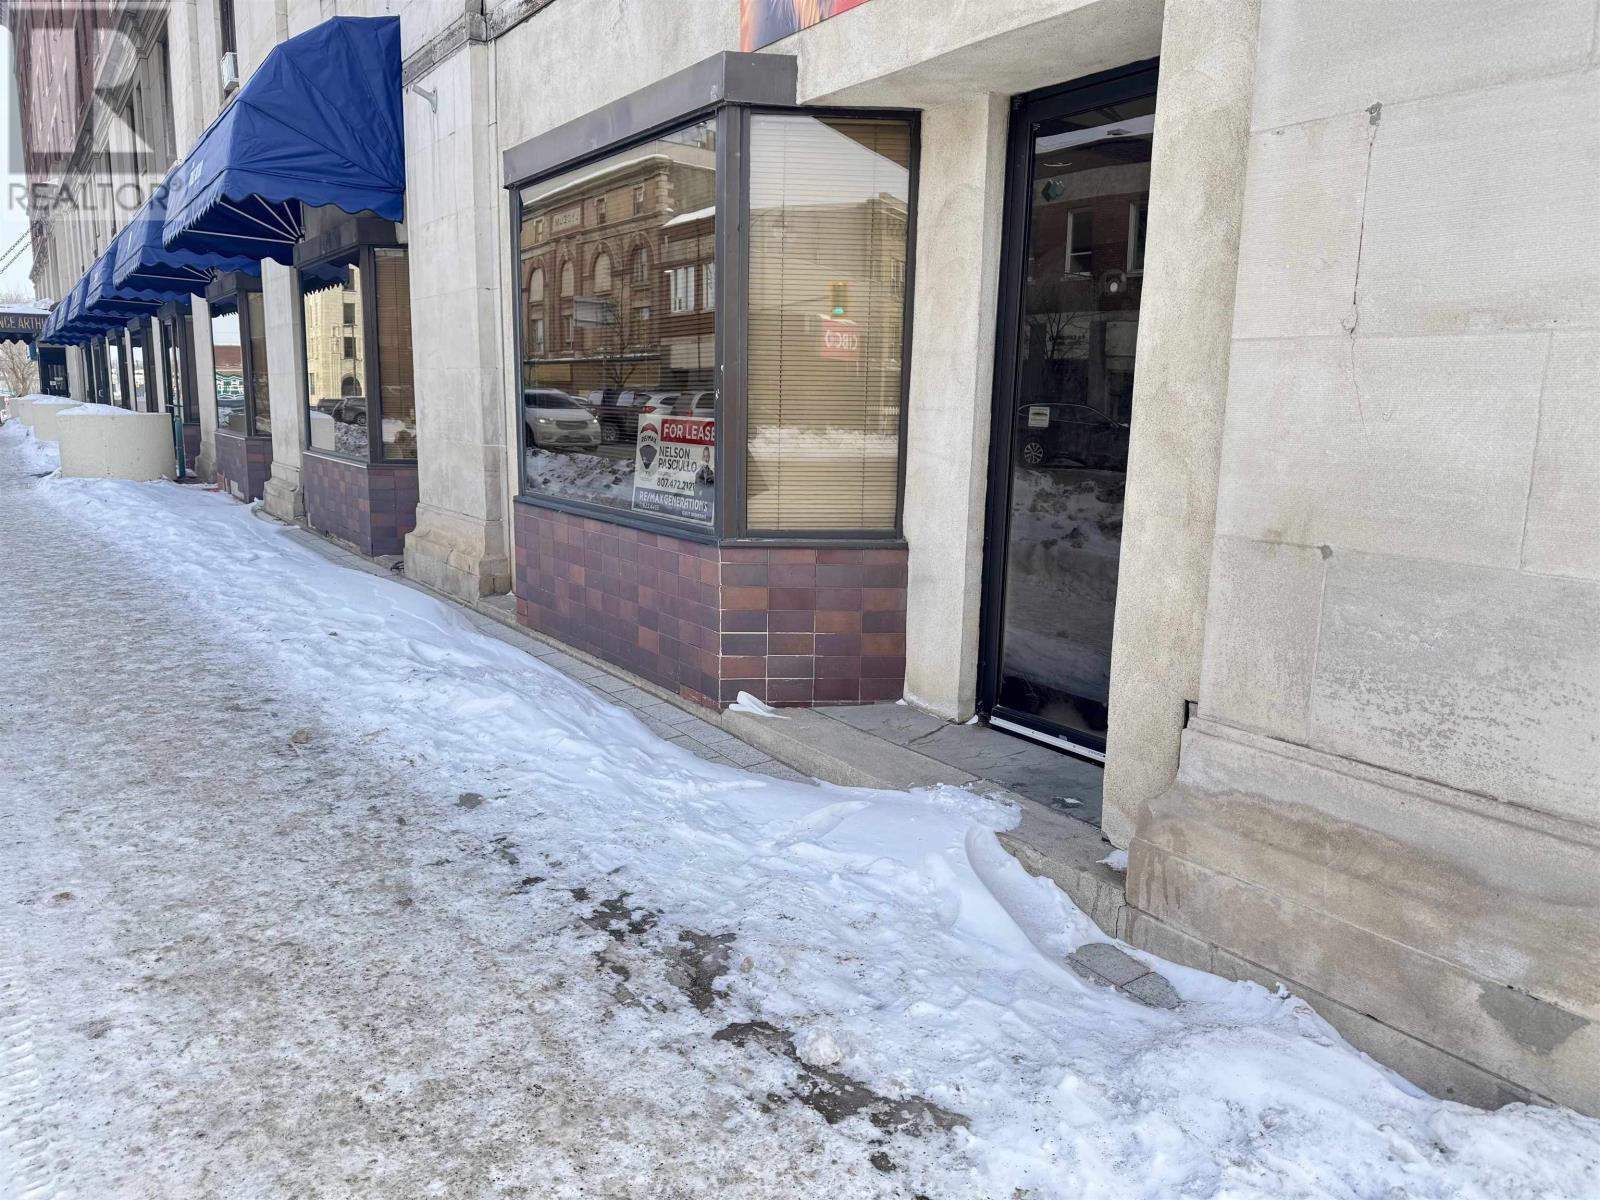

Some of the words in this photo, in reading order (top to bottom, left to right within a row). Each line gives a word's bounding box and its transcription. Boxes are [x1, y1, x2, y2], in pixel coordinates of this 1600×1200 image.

[663, 424, 683, 438] FOR
[686, 425, 715, 442] LEASE
[659, 446, 691, 460] NELSON
[640, 490, 664, 505] RE/MAX
